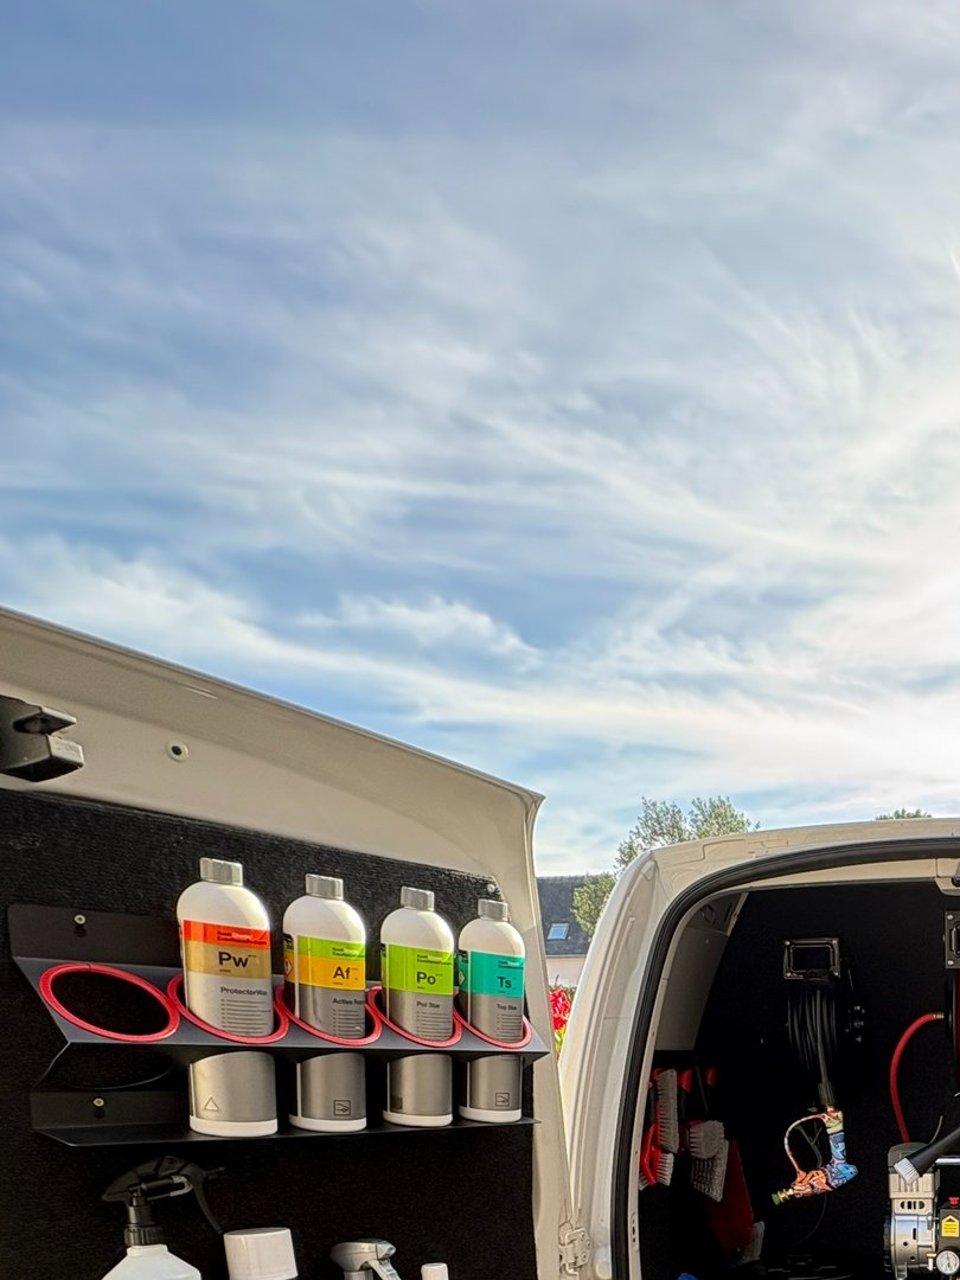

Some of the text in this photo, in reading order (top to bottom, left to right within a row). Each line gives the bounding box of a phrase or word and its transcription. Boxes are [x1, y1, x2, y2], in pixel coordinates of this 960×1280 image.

[218, 951, 249, 968] Pw
[333, 965, 351, 980] Af
[416, 971, 437, 985] Po
[497, 975, 513, 989] Ts
